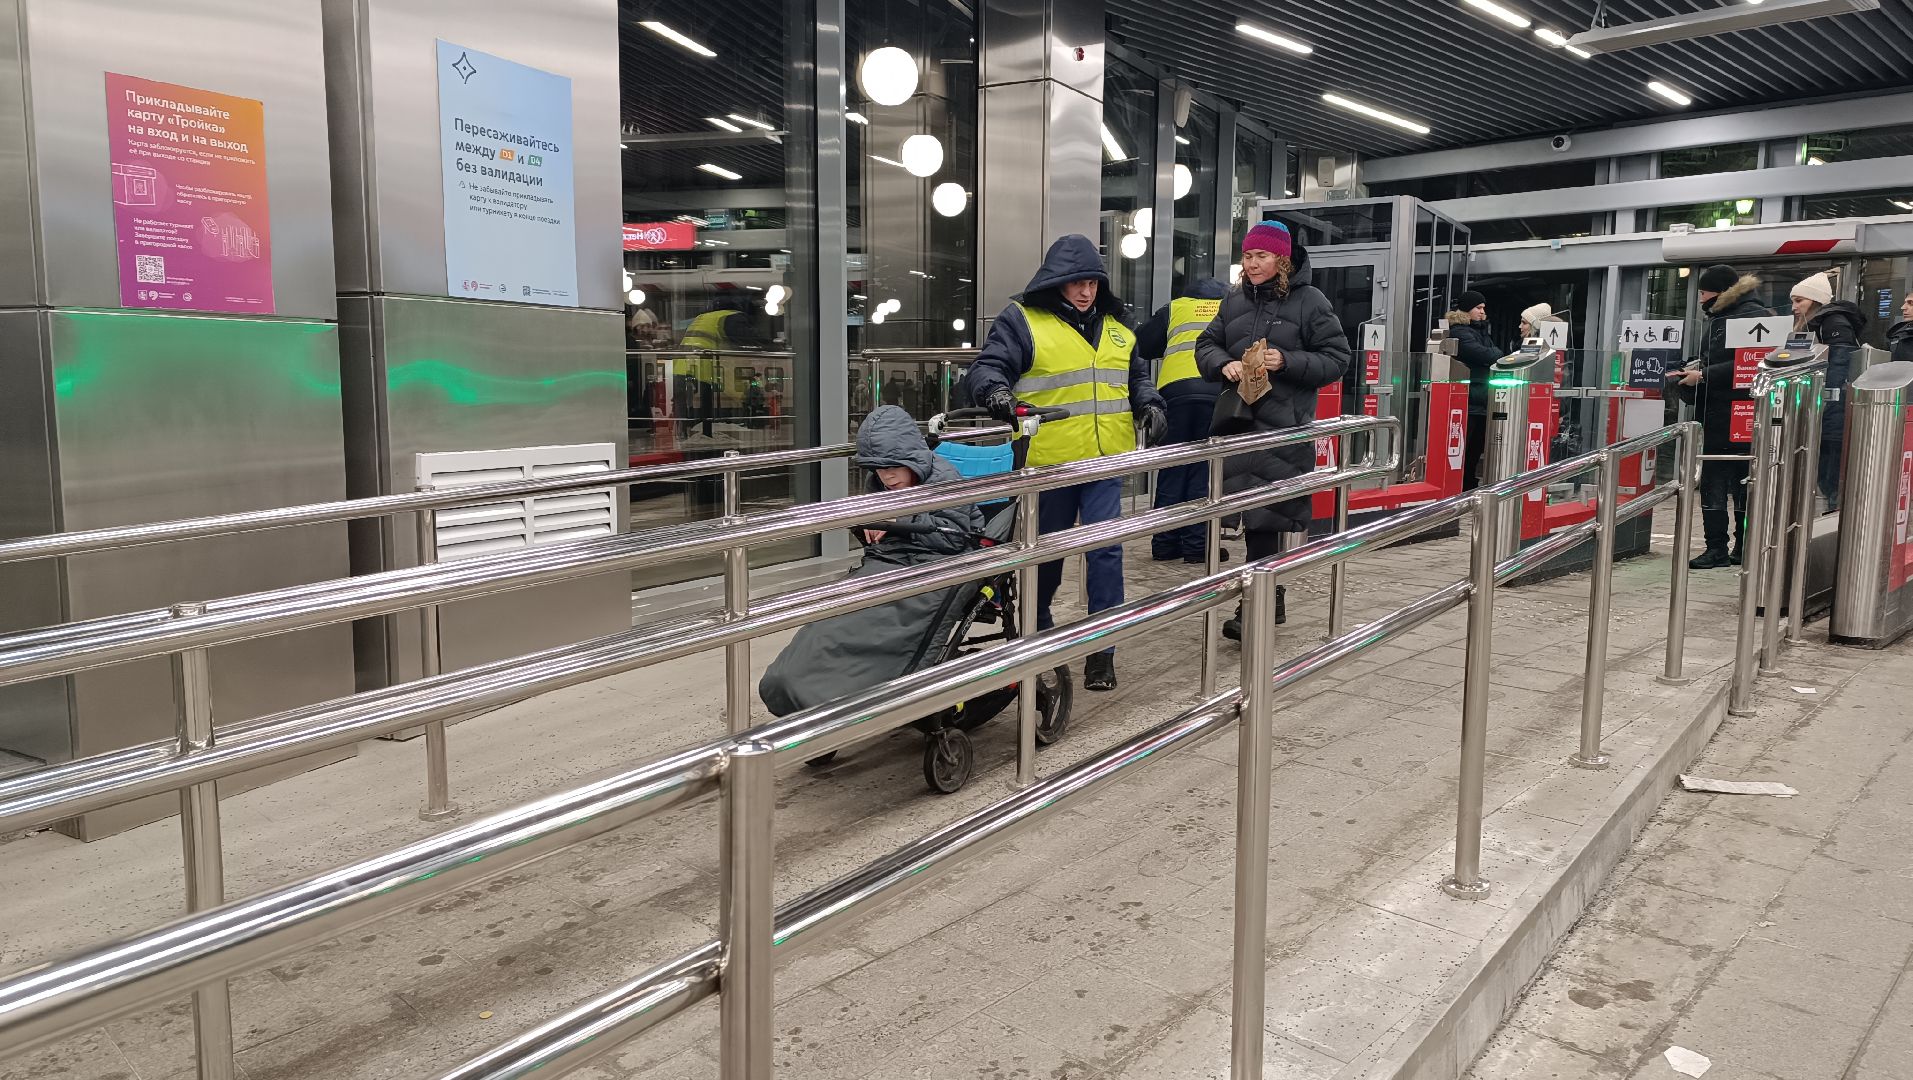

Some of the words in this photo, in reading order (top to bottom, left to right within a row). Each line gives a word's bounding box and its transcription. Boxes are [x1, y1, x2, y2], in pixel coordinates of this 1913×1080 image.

[125, 89, 230, 120] Прикладывайте
[127, 109, 164, 125] карту
[168, 114, 226, 134] «Тройка»
[127, 124, 144, 135] на
[147, 127, 179, 142] вход
[181, 133, 189, 143] и
[193, 135, 207, 145] на
[210, 138, 249, 153] выход
[127, 138, 148, 148] Карта
[454, 118, 560, 153] Пересаживайтесь
[455, 141, 496, 160] между
[502, 150, 513, 160] D1
[517, 154, 524, 164] и
[531, 156, 541, 165] D4
[456, 157, 477, 174] без
[480, 165, 543, 187] валидации
[469, 182, 479, 191] Не
[469, 194, 487, 203] карту
[1496, 391, 1507, 399] 17
